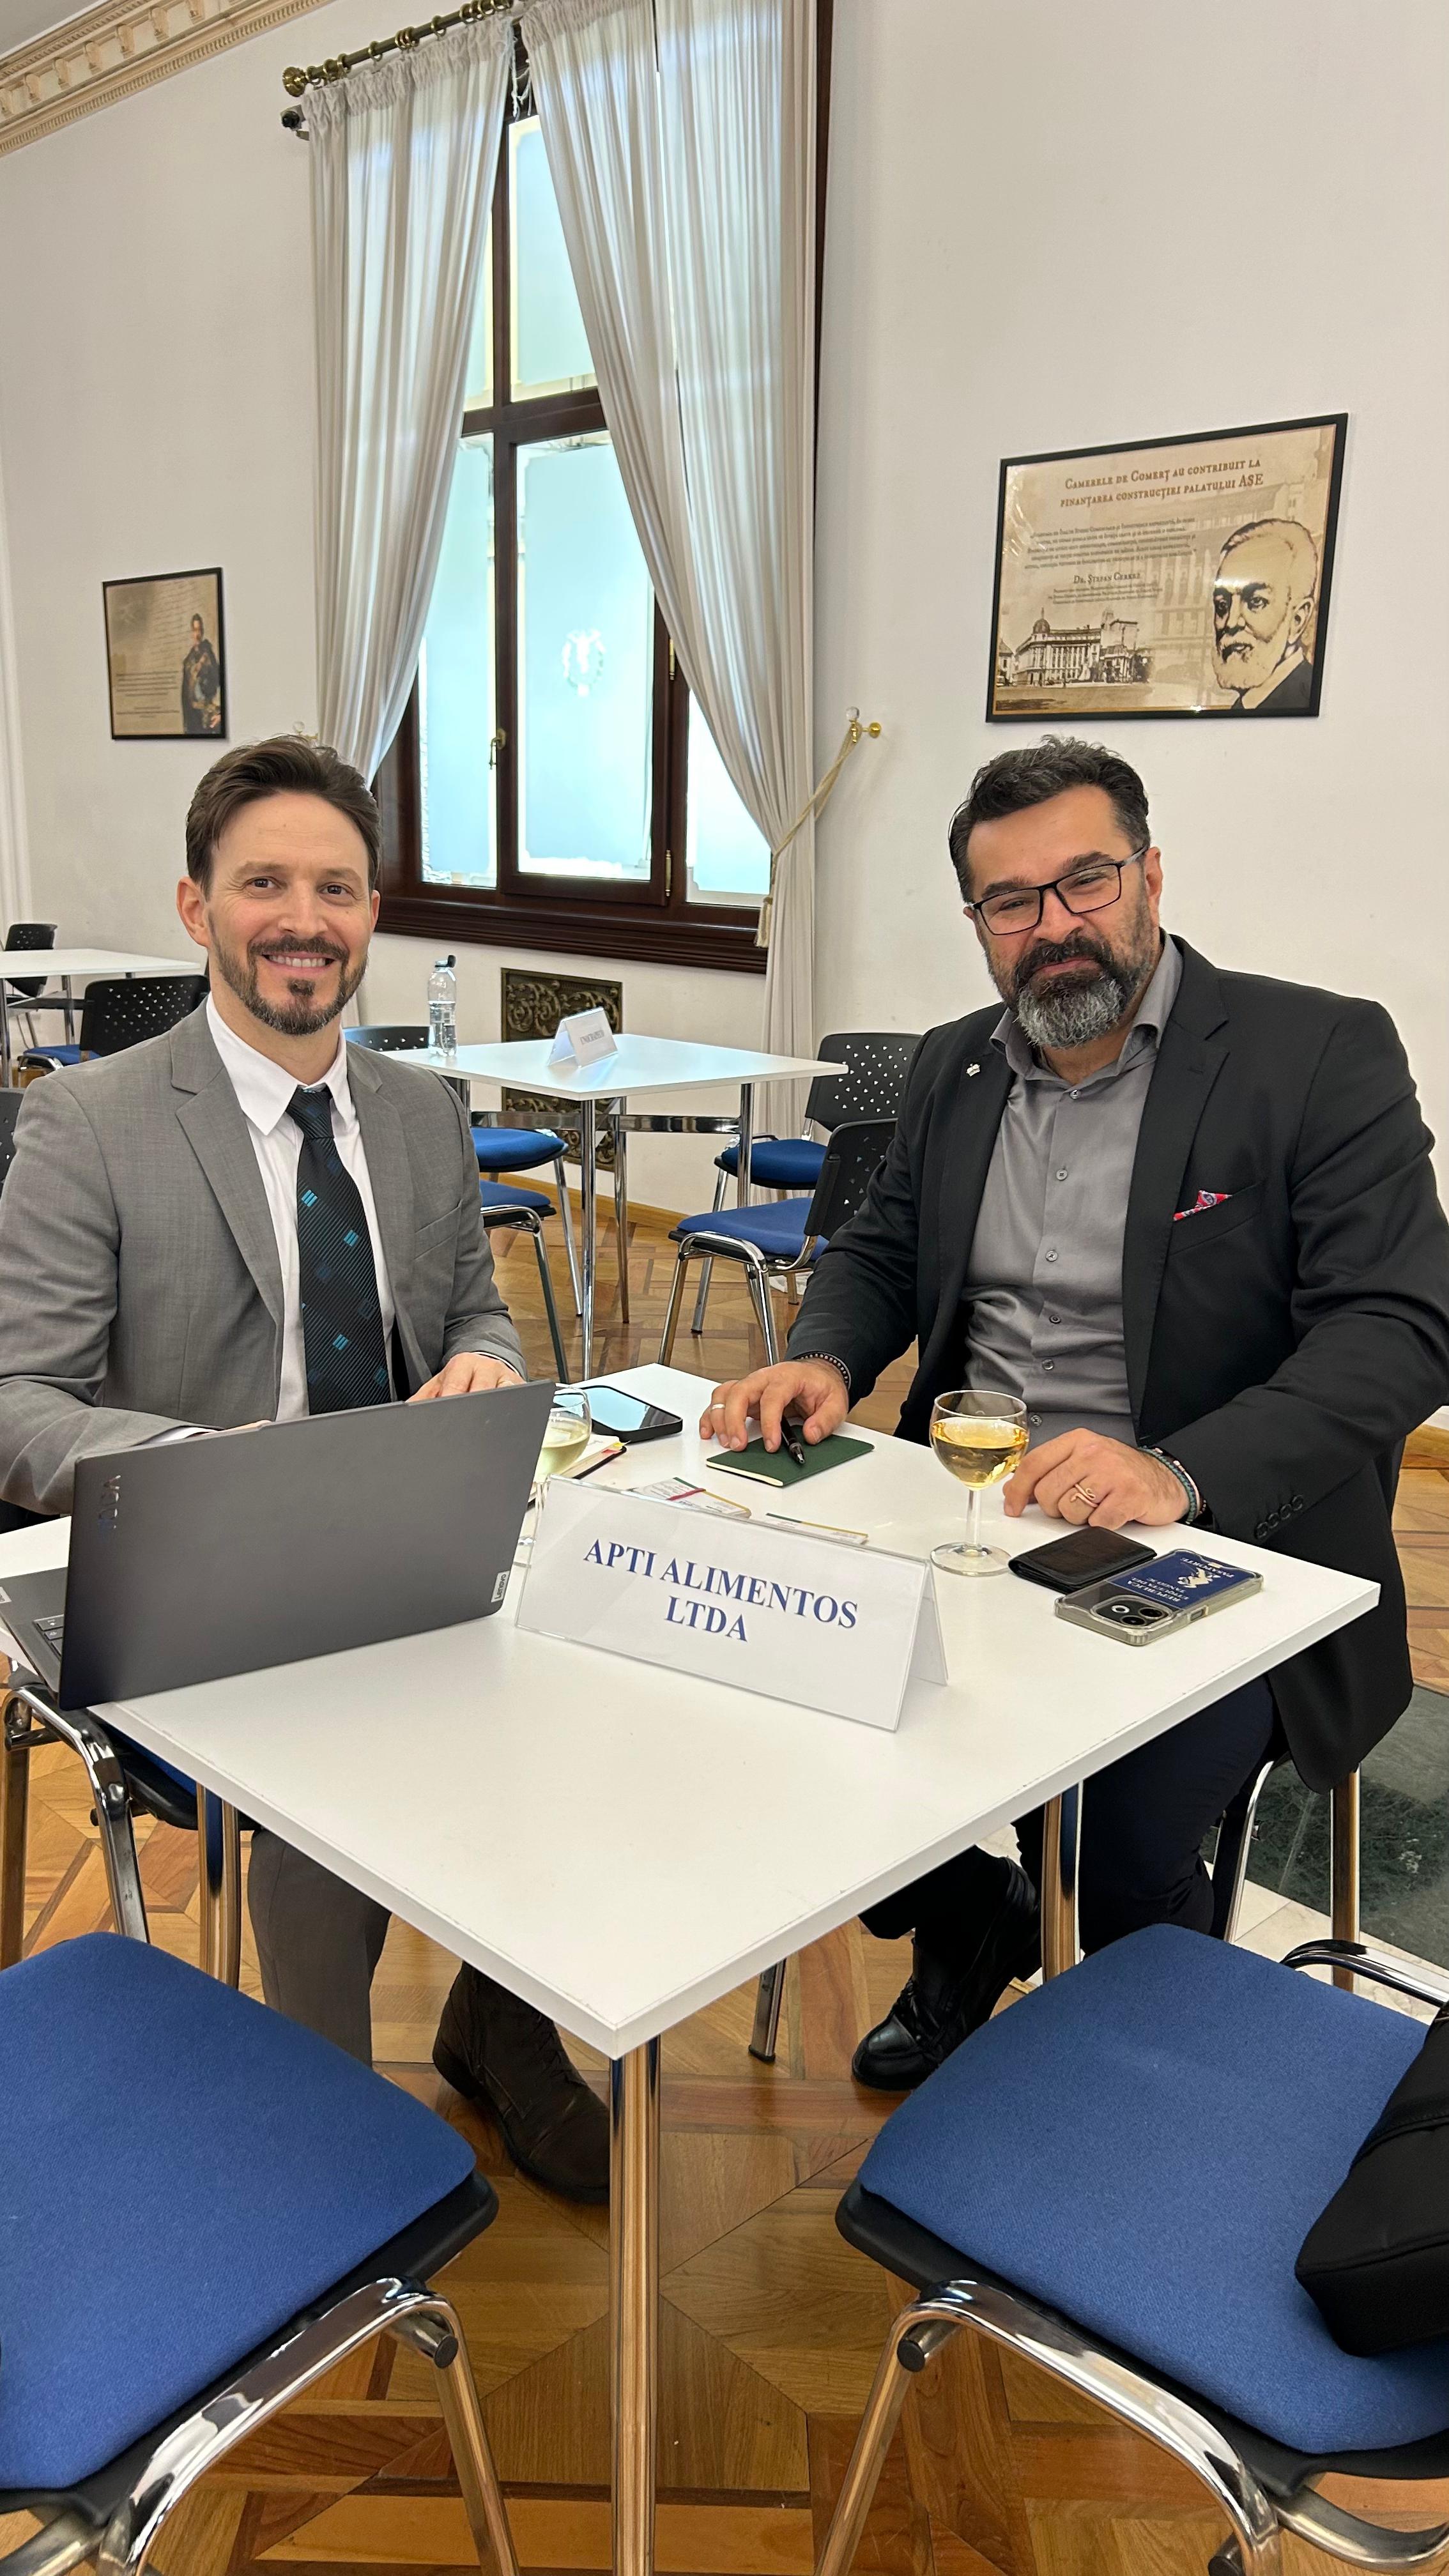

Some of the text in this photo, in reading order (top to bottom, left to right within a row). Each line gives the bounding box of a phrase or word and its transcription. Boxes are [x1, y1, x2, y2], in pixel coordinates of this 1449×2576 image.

[1173, 468, 1184, 477] AU
[1188, 460, 1246, 475] CONTRIBUIT
[1248, 459, 1261, 468] LA
[1184, 479, 1236, 493] PALATULUI
[1239, 473, 1263, 487] ASE
[494, 1574, 506, 1599] Lenovo
[583, 1538, 858, 1629] APTI ALIMENTOS
[665, 1596, 748, 1642] LTDA
